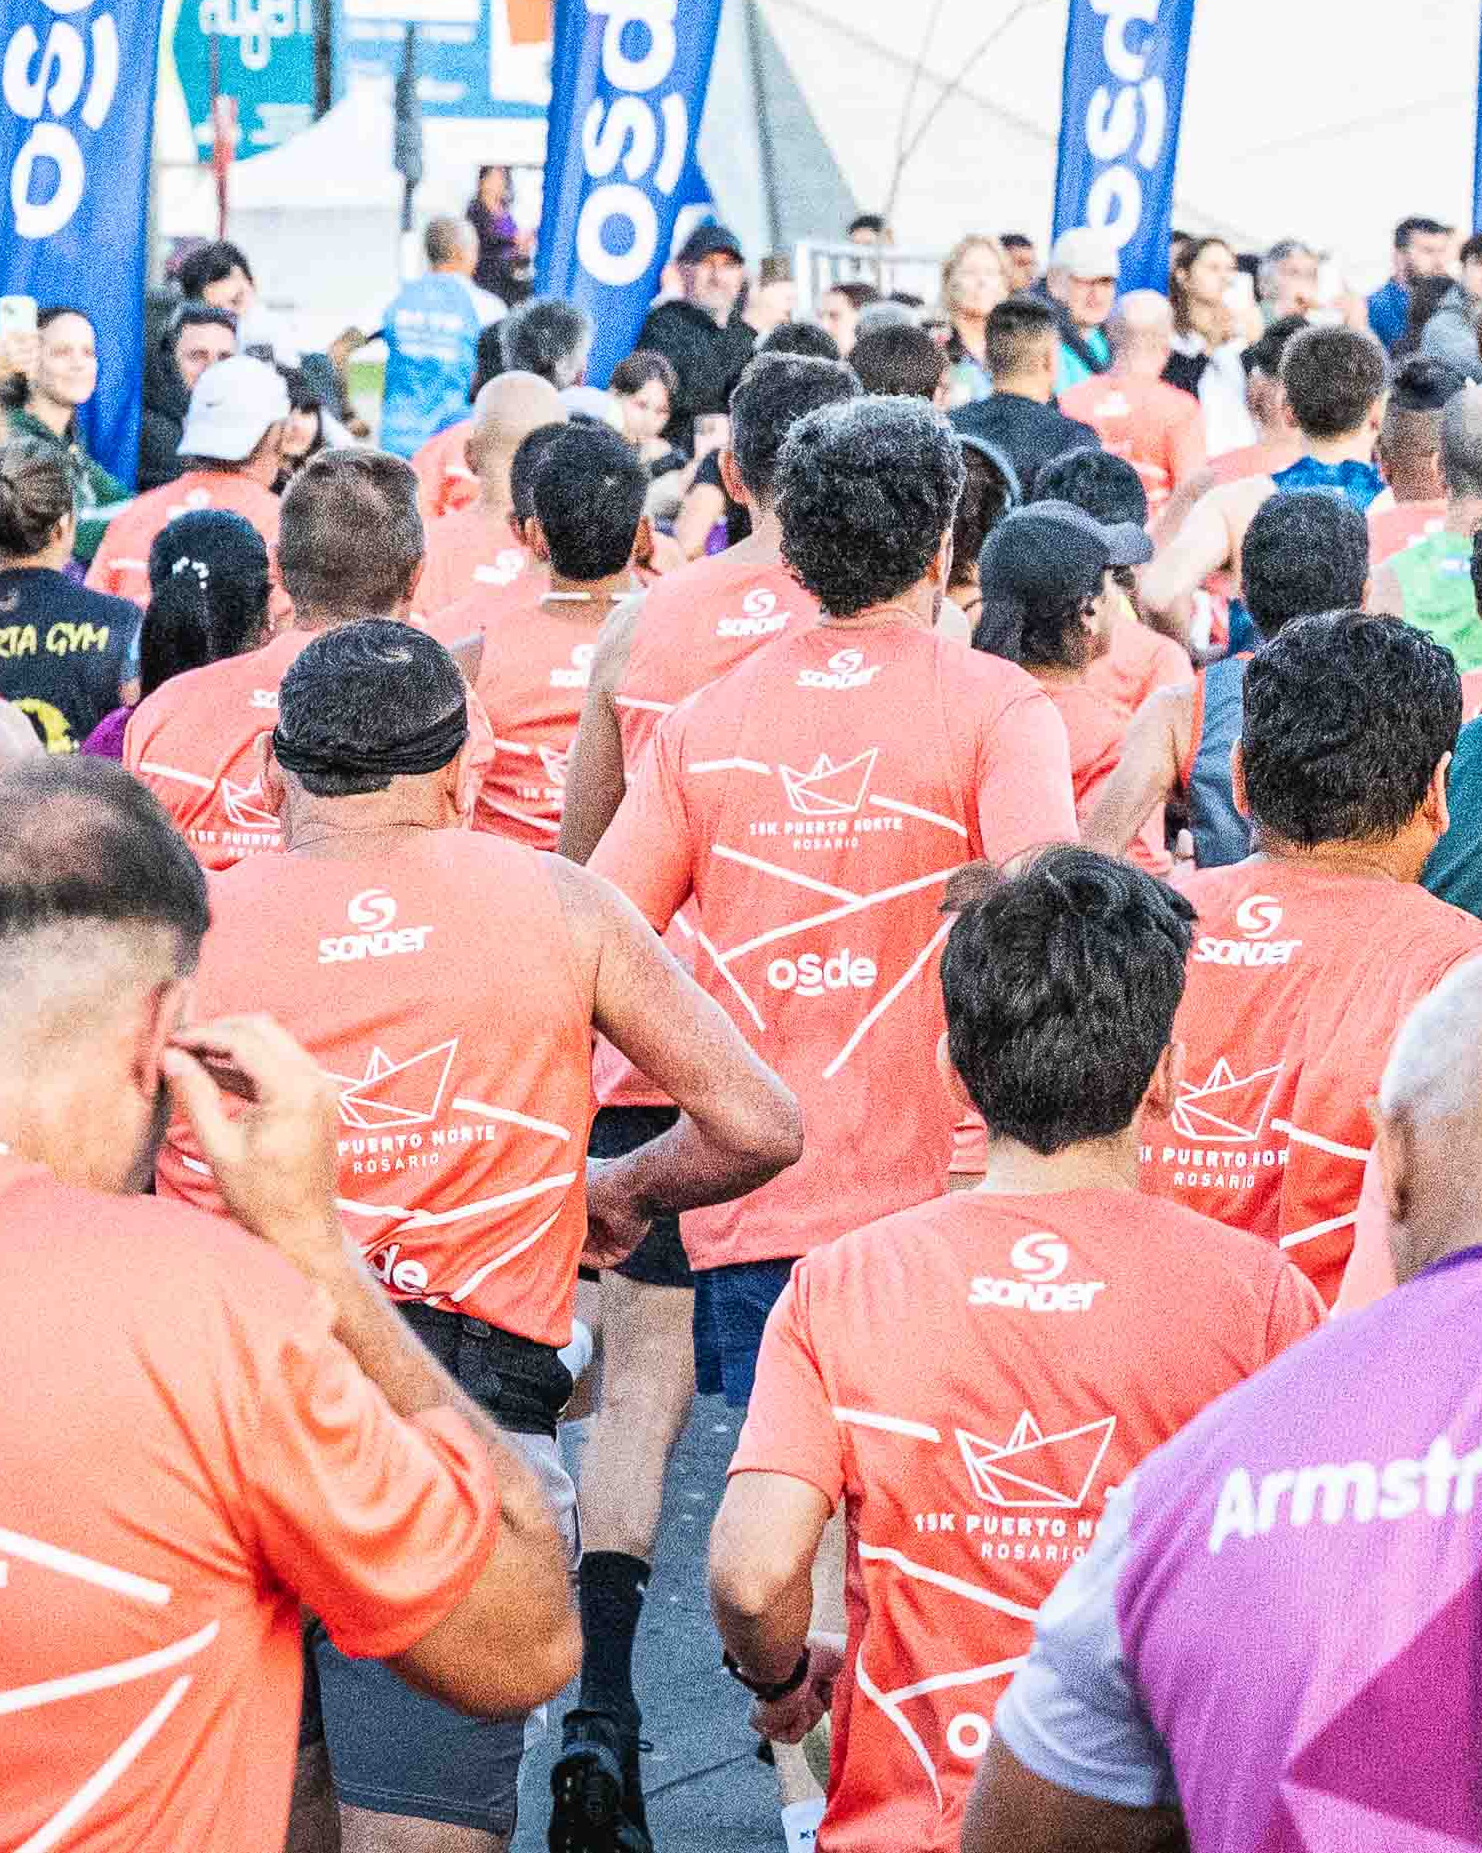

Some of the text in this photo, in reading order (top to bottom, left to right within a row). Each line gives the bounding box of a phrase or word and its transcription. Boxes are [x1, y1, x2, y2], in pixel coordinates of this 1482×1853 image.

[767, 947, 878, 996] osde
[338, 1124, 497, 1157] PUERTO NORTE
[353, 1153, 440, 1175] ROSARIO
[1162, 1147, 1248, 1168] PUERTO
[1173, 1171, 1255, 1189] ROSARIO
[914, 1512, 956, 1533] 15K
[966, 1514, 1067, 1538] PUERTO
